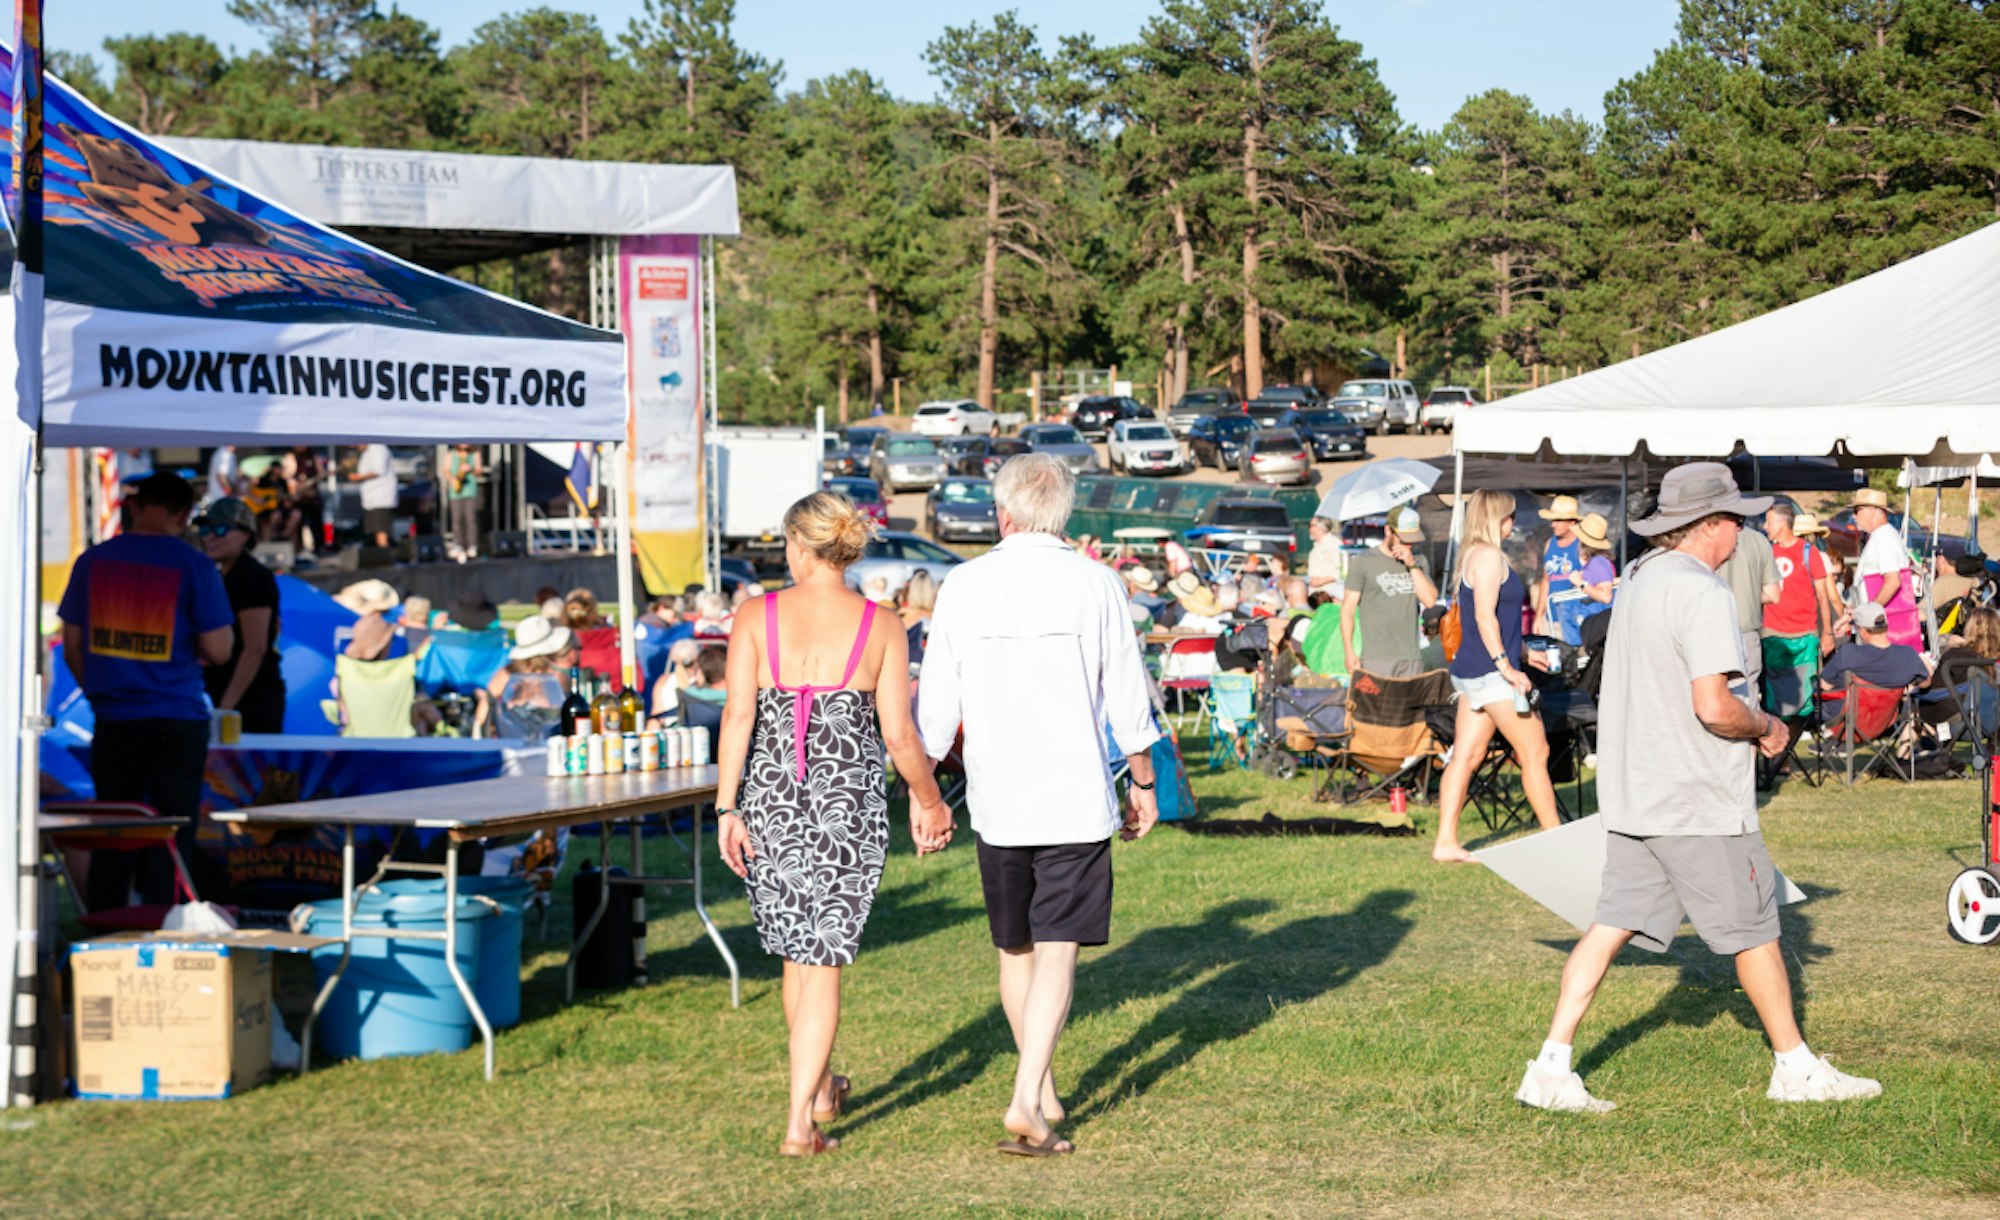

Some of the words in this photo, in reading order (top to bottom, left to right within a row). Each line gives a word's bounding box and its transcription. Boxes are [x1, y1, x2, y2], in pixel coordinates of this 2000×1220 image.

[406, 160, 460, 184] TEAM
[132, 245, 392, 292] MOUNTAIN
[161, 269, 302, 309] MUSIC
[290, 275, 417, 312] FEST
[99, 343, 587, 408] MOUNTAINMUSICFEST.ORG
[92, 626, 167, 655] VOLUNTEER
[227, 847, 342, 867] MOUNTAIN
[116, 973, 190, 998] MARG
[116, 996, 185, 1033] CUPS
